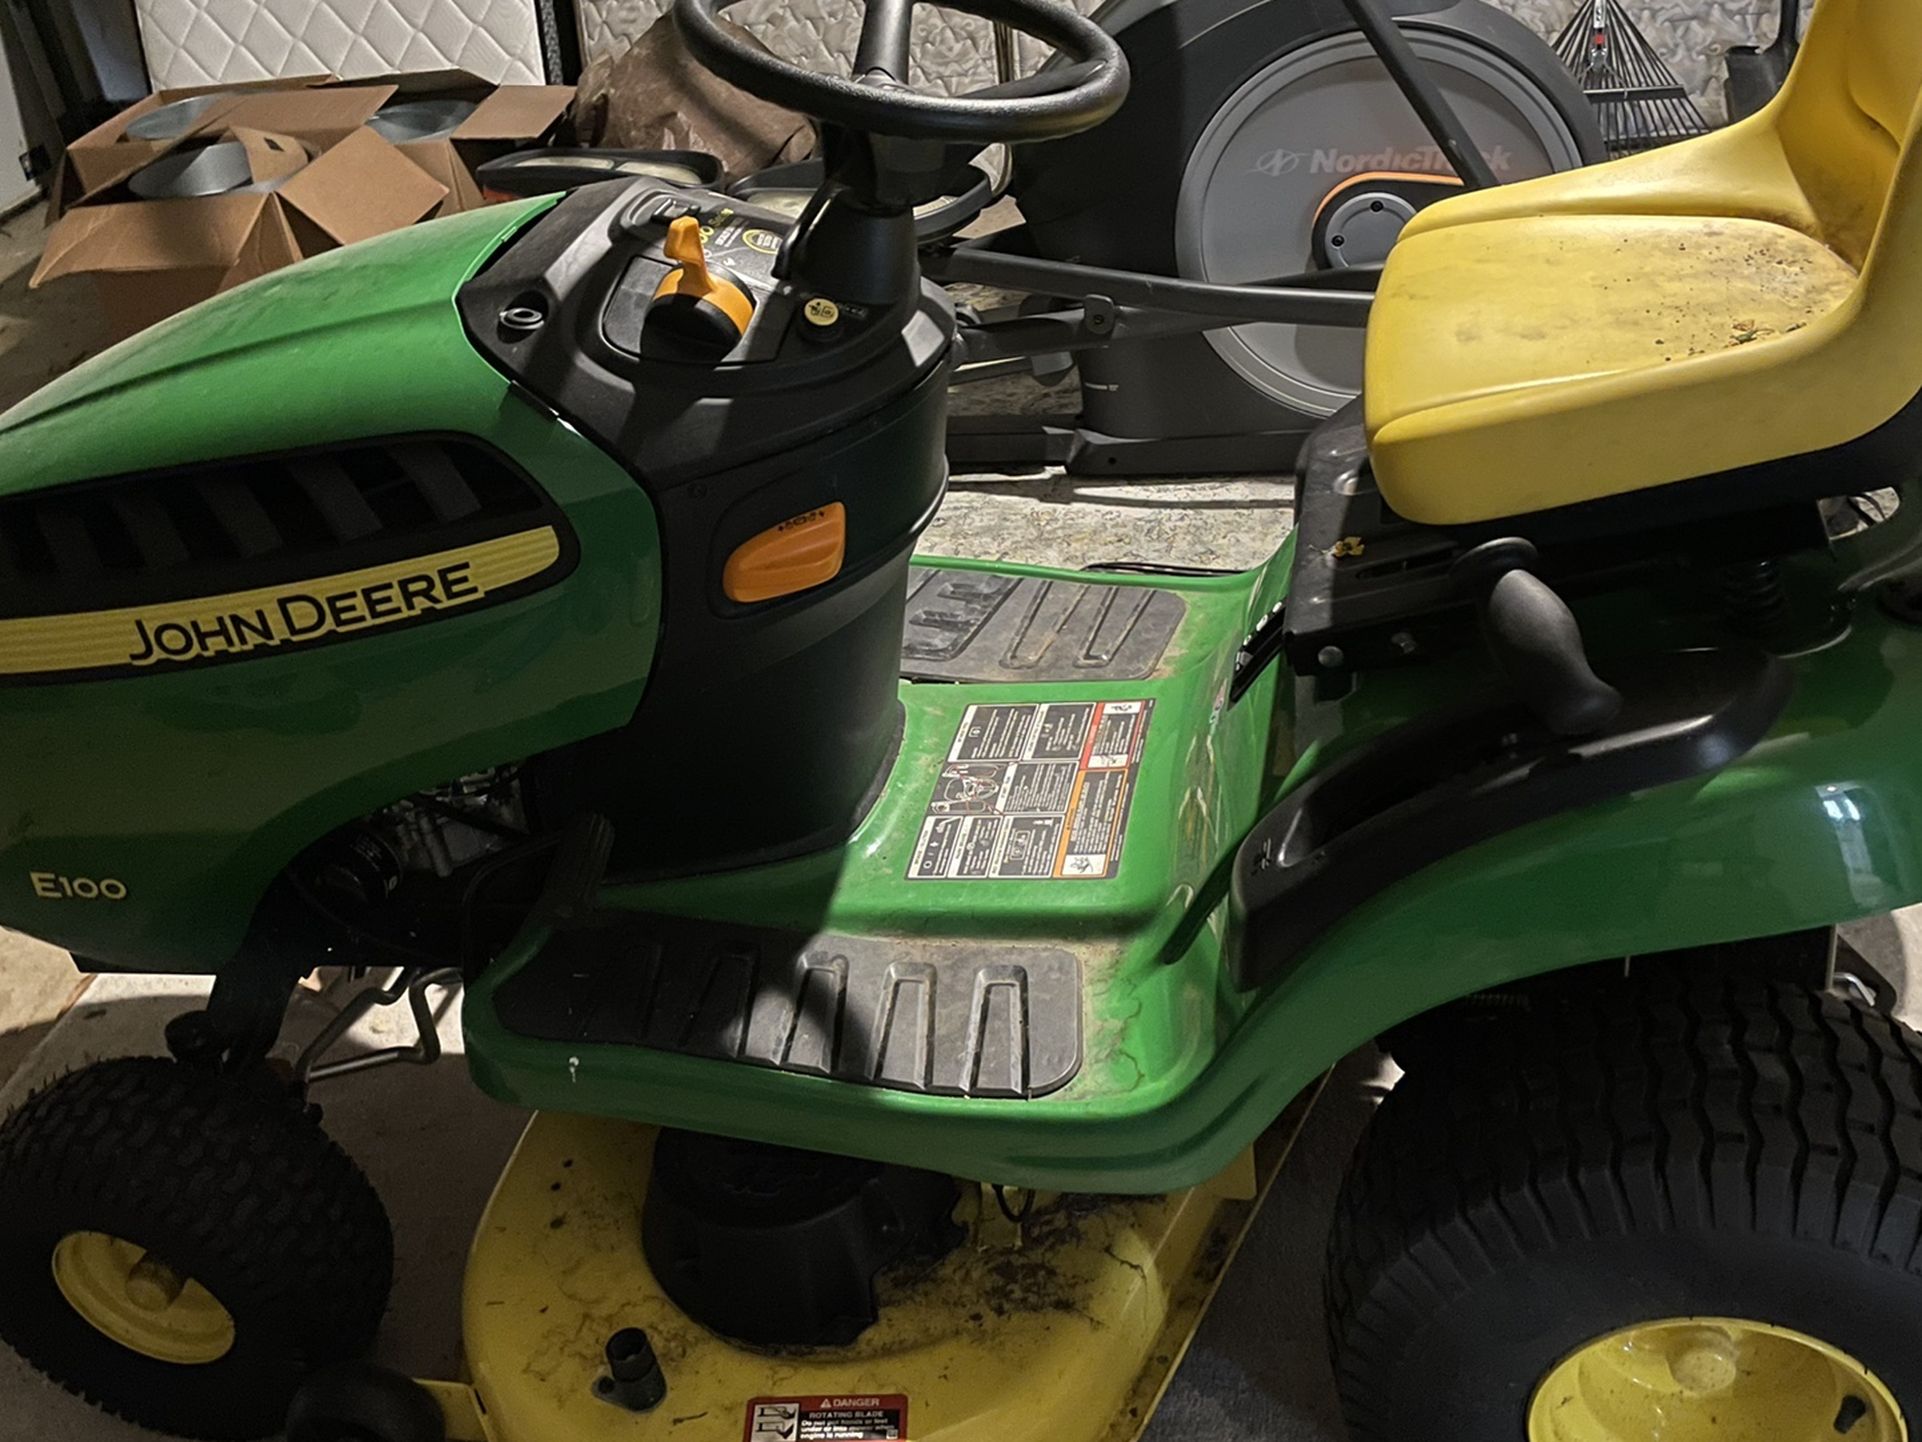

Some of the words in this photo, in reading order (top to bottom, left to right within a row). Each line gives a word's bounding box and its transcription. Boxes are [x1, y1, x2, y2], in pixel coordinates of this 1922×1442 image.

[1309, 146, 1512, 174] NordicTrk
[129, 609, 274, 662] JOHN
[276, 561, 479, 641] DEERE
[29, 871, 127, 901] E100
[809, 1411, 853, 1419] ROTATING
[854, 1410, 884, 1418] BLADE
[833, 1398, 880, 1407] DANGER
